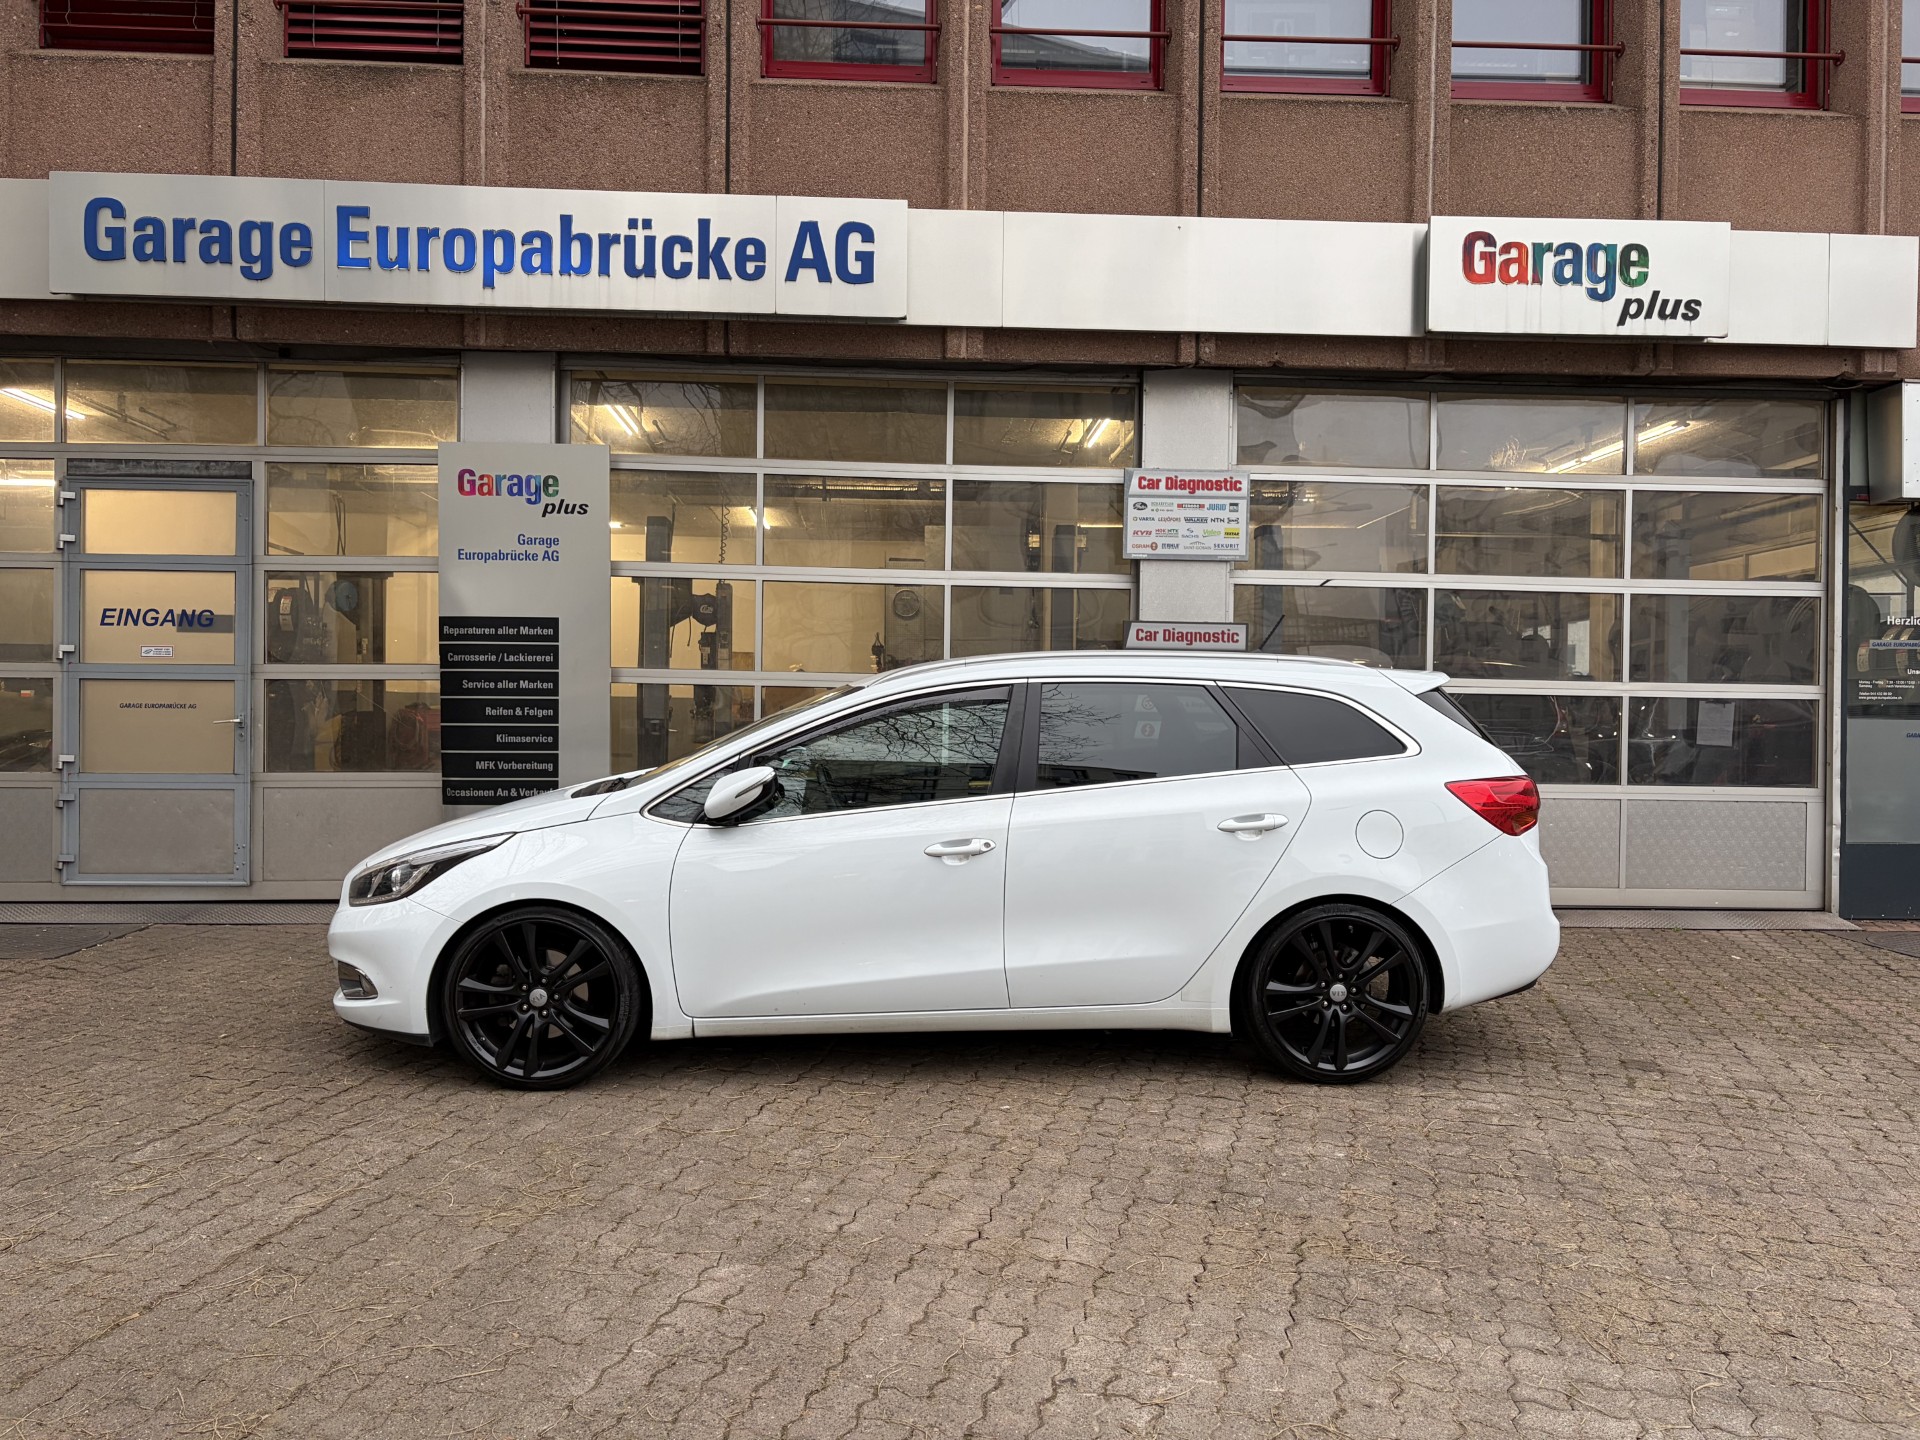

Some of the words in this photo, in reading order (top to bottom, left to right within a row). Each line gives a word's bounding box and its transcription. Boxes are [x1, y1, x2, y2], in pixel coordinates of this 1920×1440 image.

[84, 197, 312, 281] Garage
[336, 205, 767, 289] Europabrücke
[785, 220, 876, 286] AG
[1462, 230, 1649, 302] Garage
[1617, 289, 1702, 326] plus
[457, 469, 559, 505] Garage
[1137, 476, 1162, 490] Car
[1165, 475, 1242, 494] Diagnostic
[541, 499, 589, 518] plus
[517, 533, 560, 549] Garage
[457, 548, 539, 564] Europabrücke
[542, 550, 560, 562] AG
[99, 607, 215, 628] EINGANG
[443, 626, 495, 637] Reparaturen
[498, 626, 518, 635] aller
[520, 626, 554, 636] Marken
[1136, 628, 1158, 642] Car
[1163, 628, 1240, 646] Diagnostic
[447, 652, 496, 662] Carrosserie
[498, 653, 502, 662] /
[504, 653, 554, 662] Lackiererei
[462, 680, 495, 689] Service
[498, 680, 518, 689] aller
[520, 680, 554, 689] Marken
[486, 706, 514, 716] Reifen
[515, 707, 522, 716] &
[524, 707, 554, 718] Felgen
[496, 734, 554, 743] Klimaservice
[476, 760, 495, 770] MFK
[497, 761, 554, 772] Vorbereitung
[446, 788, 495, 797] Occasionen
[496, 788, 508, 797] An
[510, 788, 518, 797] &
